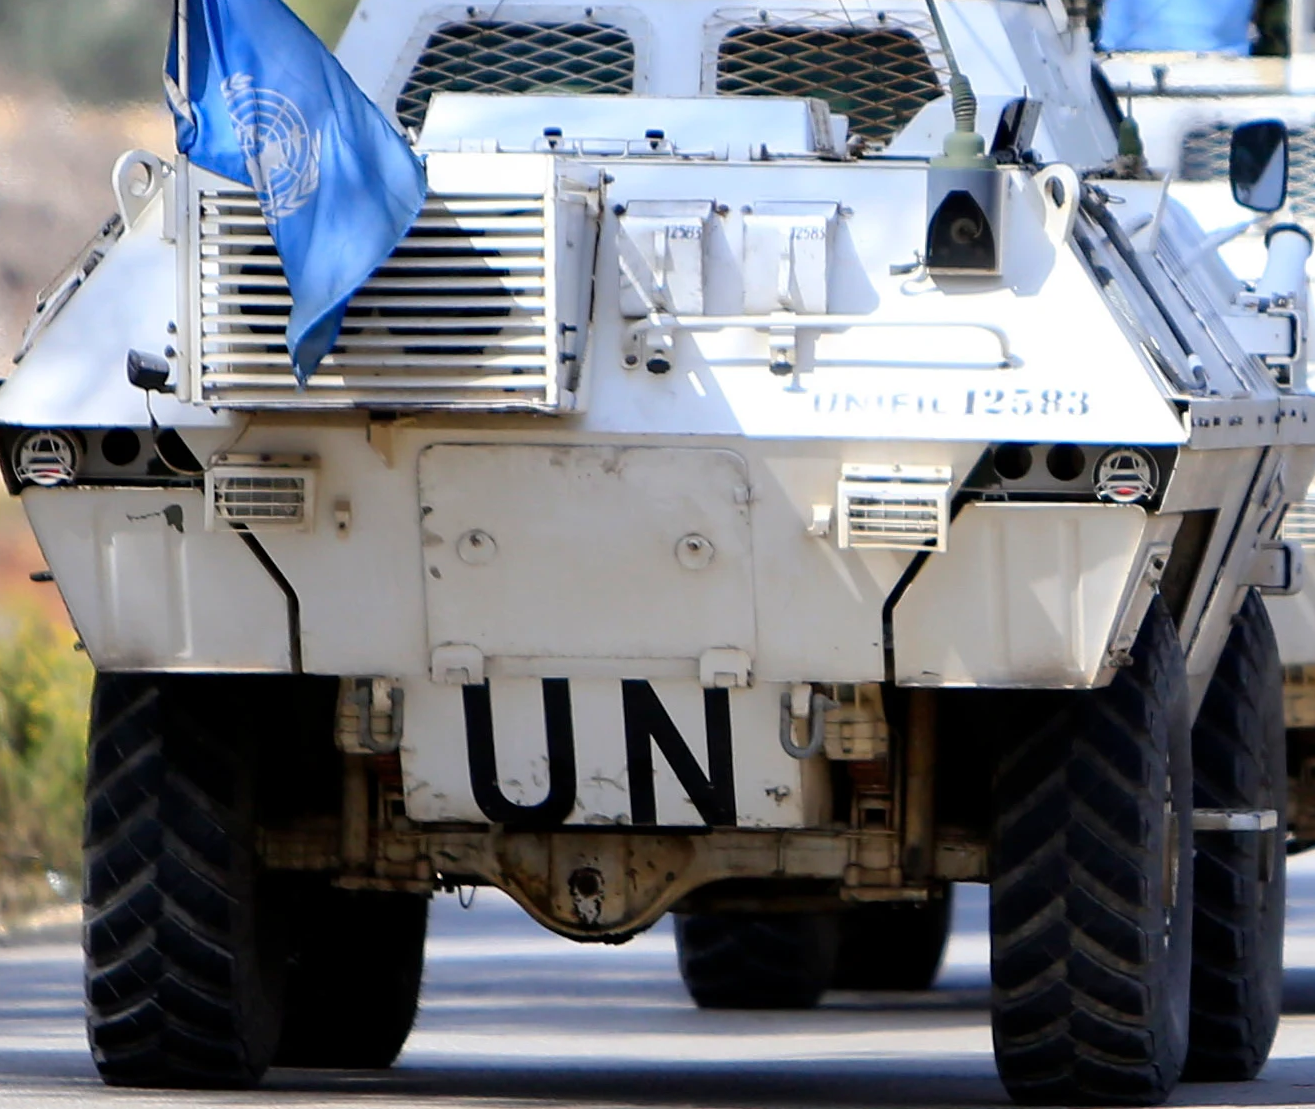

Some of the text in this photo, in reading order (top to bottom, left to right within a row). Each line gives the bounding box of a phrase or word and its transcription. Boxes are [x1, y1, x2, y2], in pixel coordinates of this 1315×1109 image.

[813, 389, 1089, 416] UNIFIL 12583
[462, 677, 737, 828] UN
